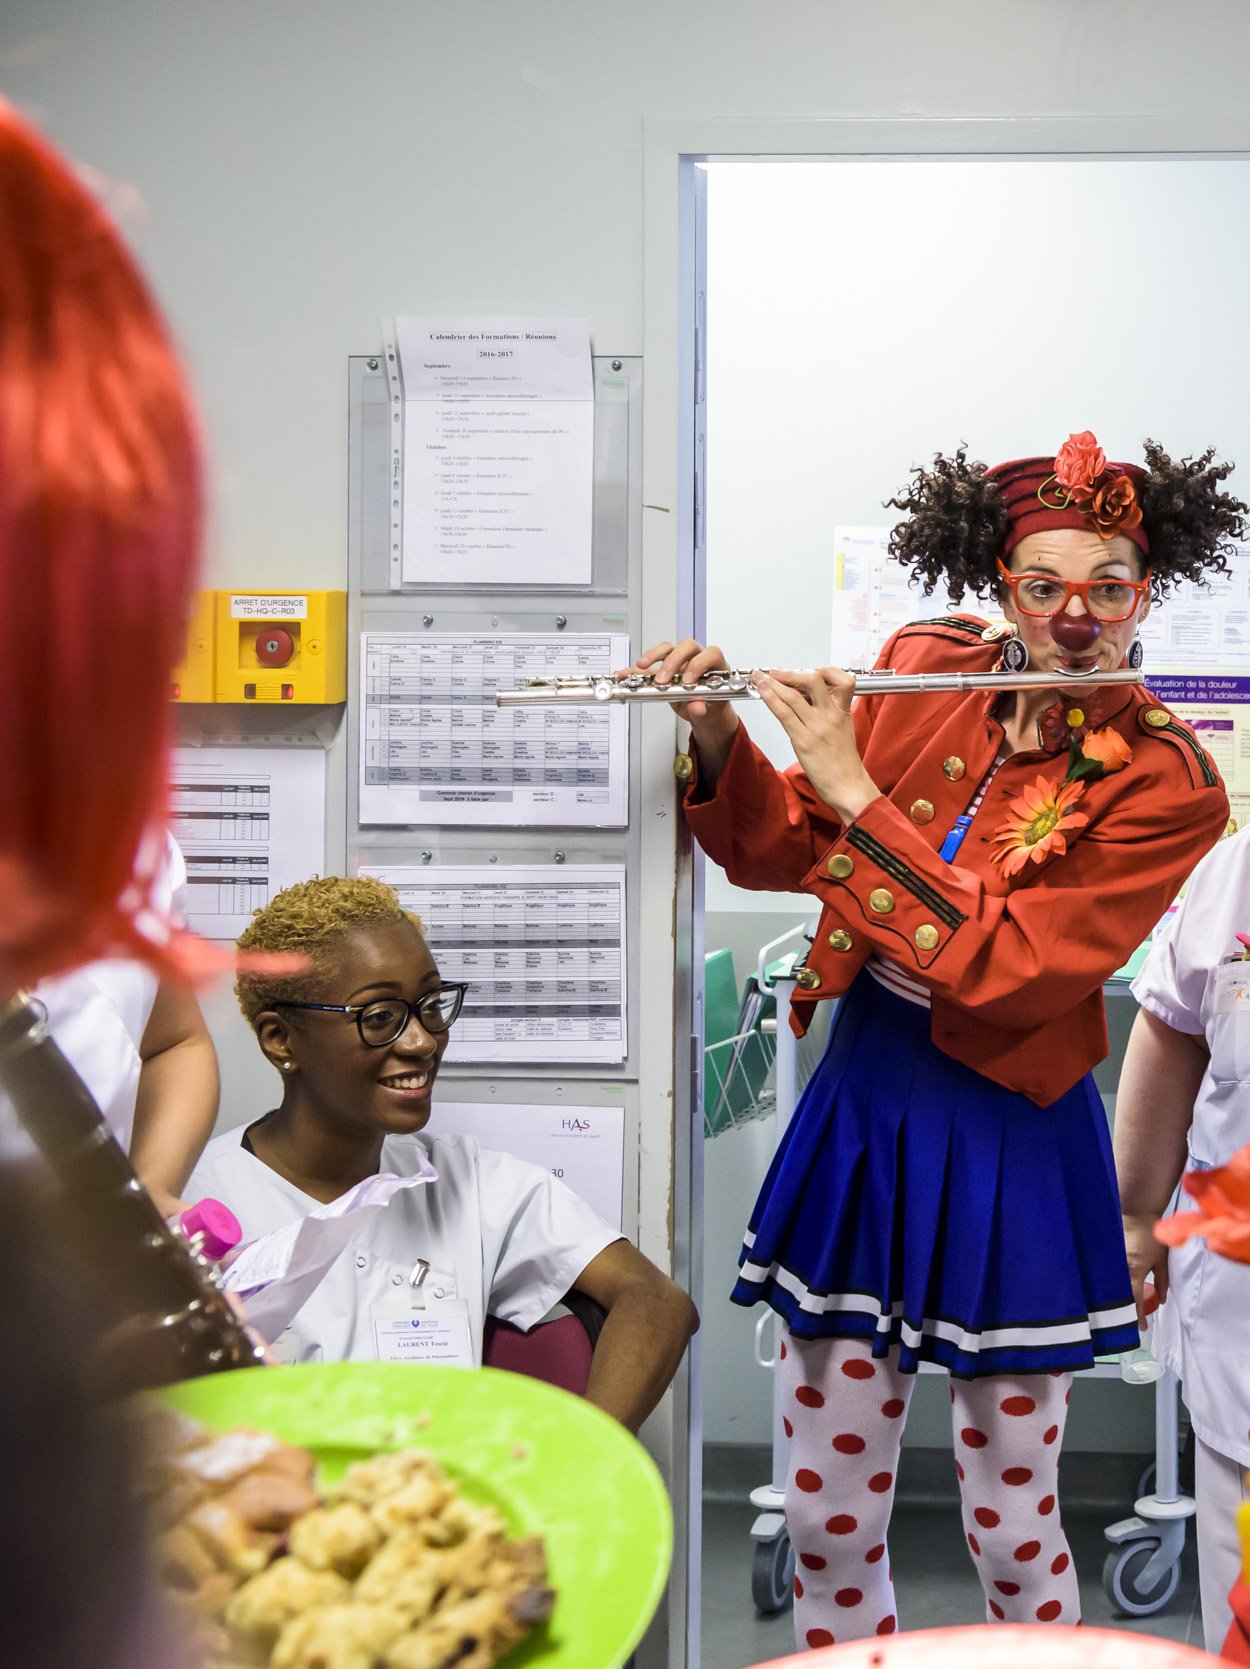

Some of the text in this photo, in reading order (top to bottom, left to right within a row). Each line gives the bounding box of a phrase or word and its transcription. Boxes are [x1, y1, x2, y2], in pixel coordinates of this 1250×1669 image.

[1144, 680, 1237, 688] Évaluation de la douleur
[1156, 691, 1184, 700] l'enfant
[1188, 691, 1195, 700] et
[1197, 691, 1207, 700] de
[562, 1118, 590, 1132] HAS
